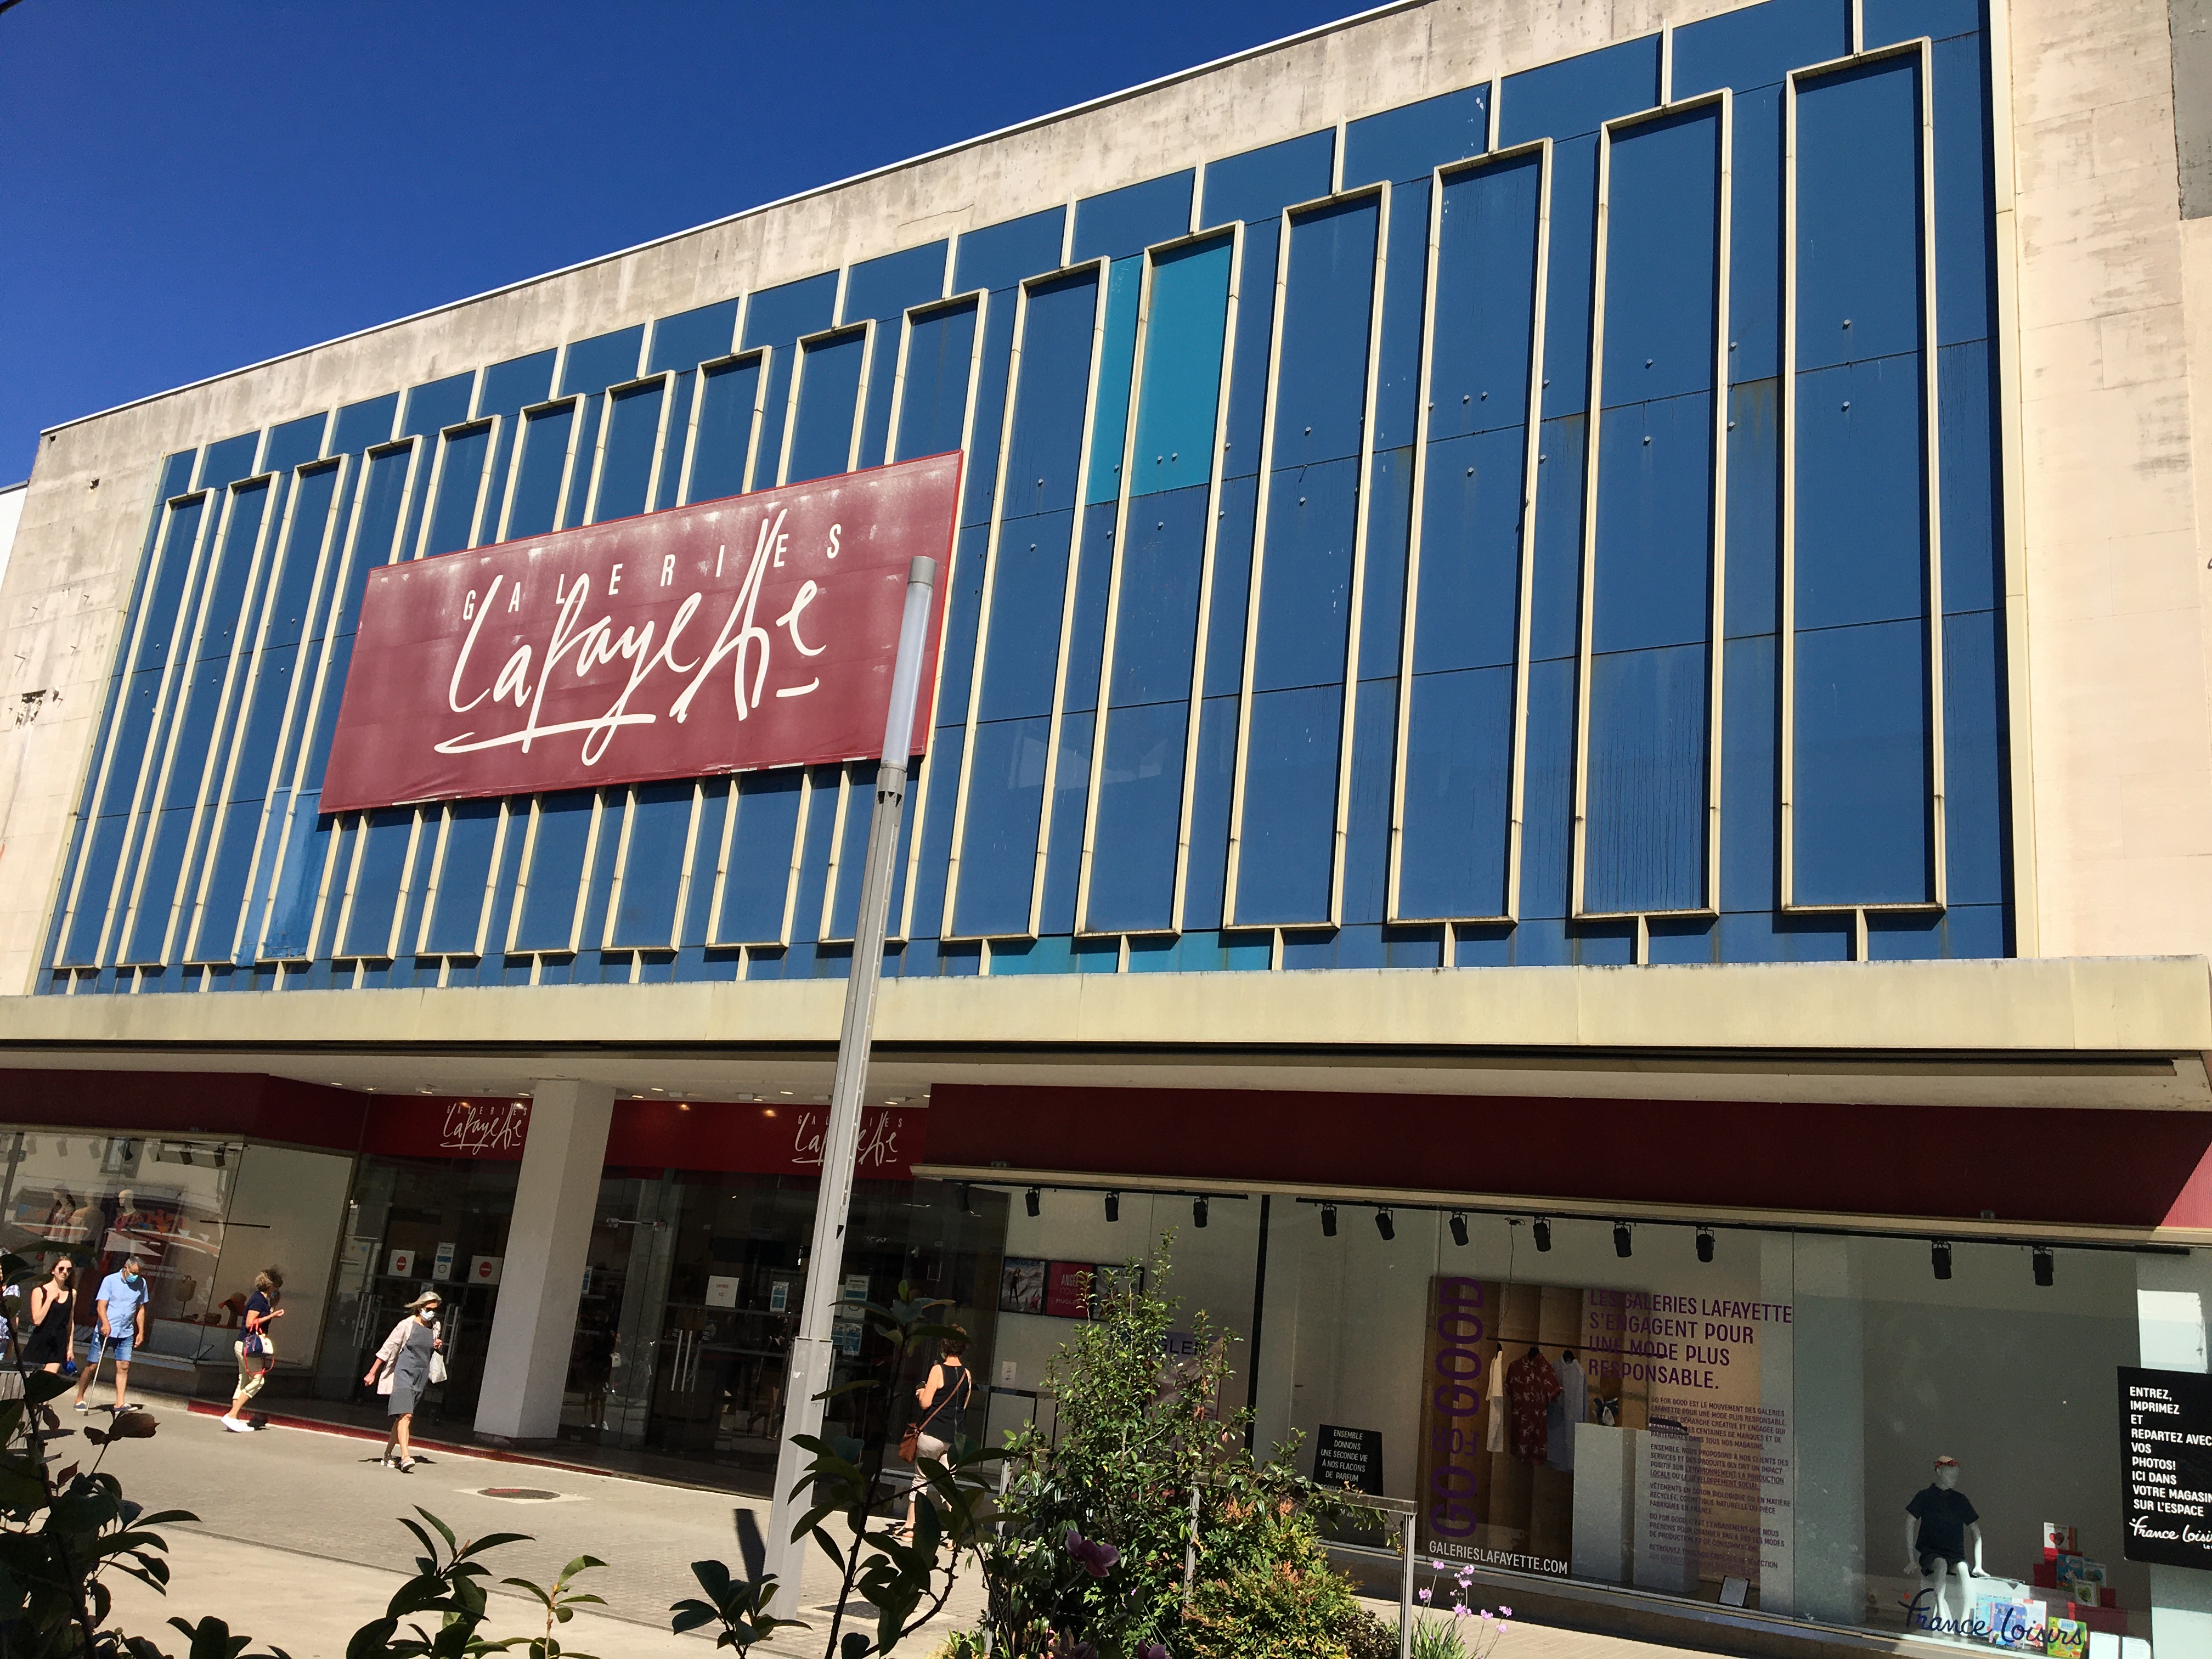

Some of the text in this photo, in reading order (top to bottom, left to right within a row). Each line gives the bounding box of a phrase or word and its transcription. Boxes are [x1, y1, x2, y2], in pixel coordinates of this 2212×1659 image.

[462, 522, 842, 621] GALERIES
[433, 507, 827, 766] Lafayette
[447, 1105, 527, 1116] GALERIES
[798, 1115, 902, 1127] GALIES
[440, 1102, 522, 1155] Lafayette
[1590, 1289, 1792, 1323] LES GALERIES LAFAYETTE
[1590, 1312, 1753, 1344] S'ENGAGENT POUR
[1434, 1277, 1484, 1417] GOOD
[1589, 1336, 1730, 1366] UNE MODE PLUS
[1589, 1359, 1718, 1389] RESPONSABLE.
[2130, 1386, 2172, 1402] ENTREZ,
[1651, 1406, 1680, 1414] LAFAYETTE
[1709, 1403, 1743, 1412] MOUVEMENT
[1758, 1408, 1784, 1417] GALERIES
[2130, 1401, 2180, 1415] IMPRIMEZ
[2131, 1414, 2143, 1425] ET
[1334, 1429, 1363, 1440] ENSEMBLE
[1651, 1431, 1688, 1441] PARTENAIRES
[1696, 1427, 1726, 1436] CENTAINES
[1737, 1432, 1764, 1441] MARQUES
[2131, 1428, 2212, 1446] REPARTEZ AVEC
[1334, 1440, 1361, 1451] DONNONS
[2131, 1442, 2152, 1454] VOS
[1333, 1451, 1358, 1461] SECONDE
[1359, 1454, 1368, 1462] VIE
[1651, 1452, 1676, 1461] SERVICES
[1699, 1458, 1725, 1467] PRODUITS
[1762, 1466, 1782, 1474] IMPACT
[1699, 1449, 1732, 1459] PROPOSONS
[1753, 1456, 1776, 1465] CLIENTS
[2132, 1456, 2176, 1470] PHOTOS!
[1327, 1460, 1339, 1469] NOS
[1339, 1463, 1365, 1472] FLACONS
[1650, 1461, 1671, 1469] POSITIF
[1748, 1473, 1784, 1483] PRODUCTION
[1336, 1472, 1358, 1482] PARFUM
[1650, 1470, 1671, 1478] LOCALE
[2132, 1470, 2176, 1485] ICI DANS
[1712, 1491, 1745, 1501] BIOLOGIQUE
[2133, 1485, 2166, 1498] VOTRE
[1430, 1465, 1477, 1538] GO
[1717, 1500, 1747, 1510] NATURELLE
[2134, 1499, 2204, 1517] SUR L'ESPACE
[1650, 1522, 1675, 1531] PRENONS
[1765, 1538, 1785, 1547] MODES
[1658, 1532, 1693, 1543] PRODUCTION
[1650, 1544, 1680, 1554] RETROUVEZ
[1429, 1541, 1567, 1575] GALERIESLAFAYETTE.COM
